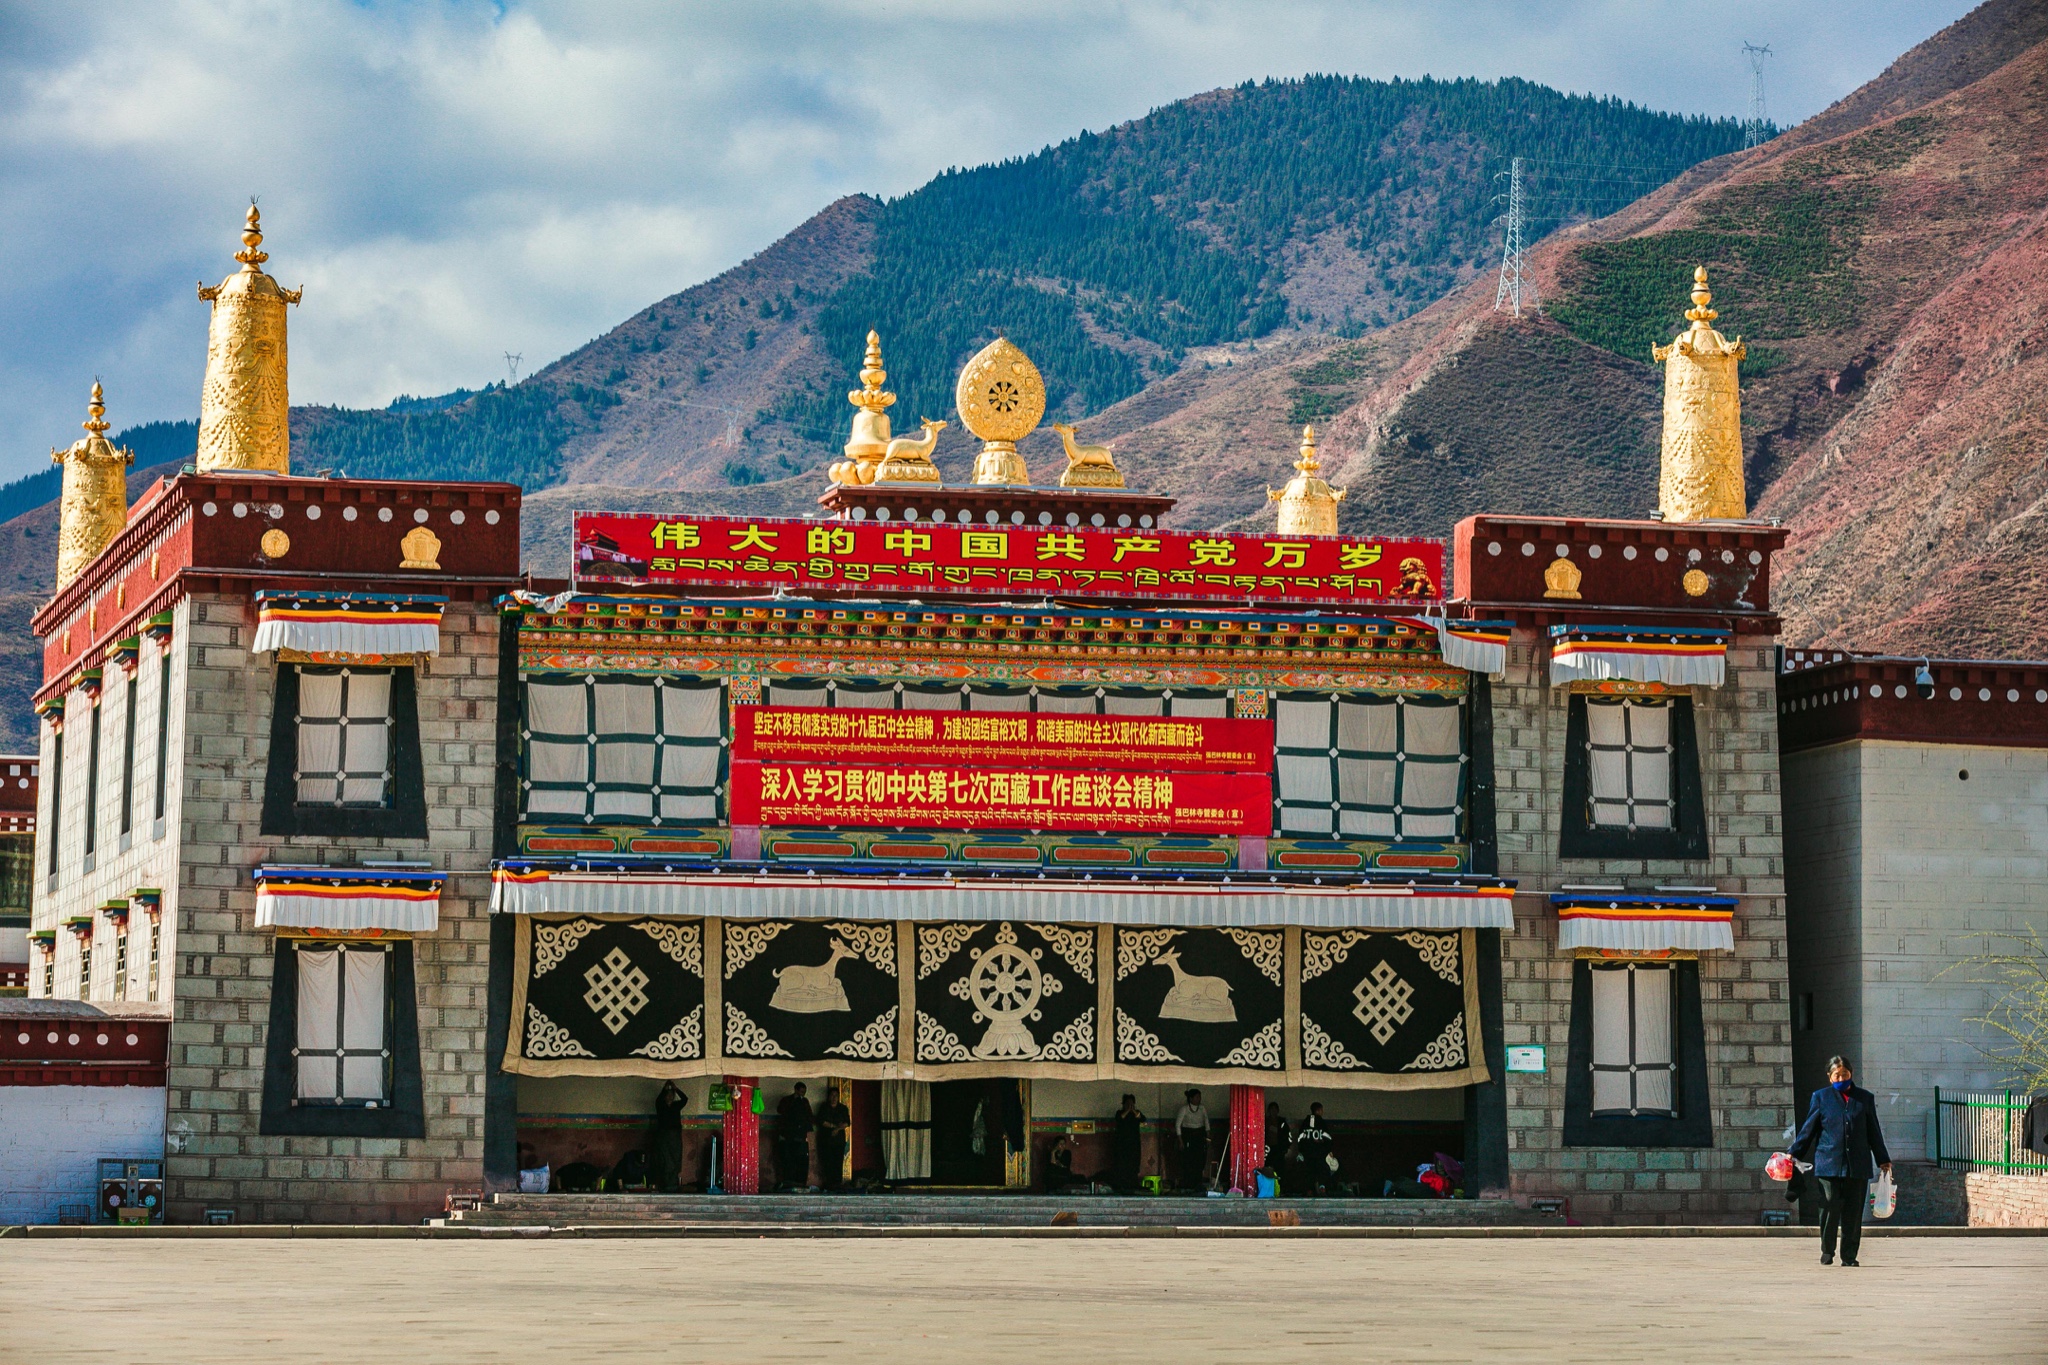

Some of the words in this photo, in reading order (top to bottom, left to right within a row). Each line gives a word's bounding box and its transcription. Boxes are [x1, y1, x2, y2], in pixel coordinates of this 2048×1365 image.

[650, 521, 1382, 570] 伟大的中国共产党万岁
[761, 767, 1173, 810] 深入学习贯彻中央第七次西藏工作座谈会精神
